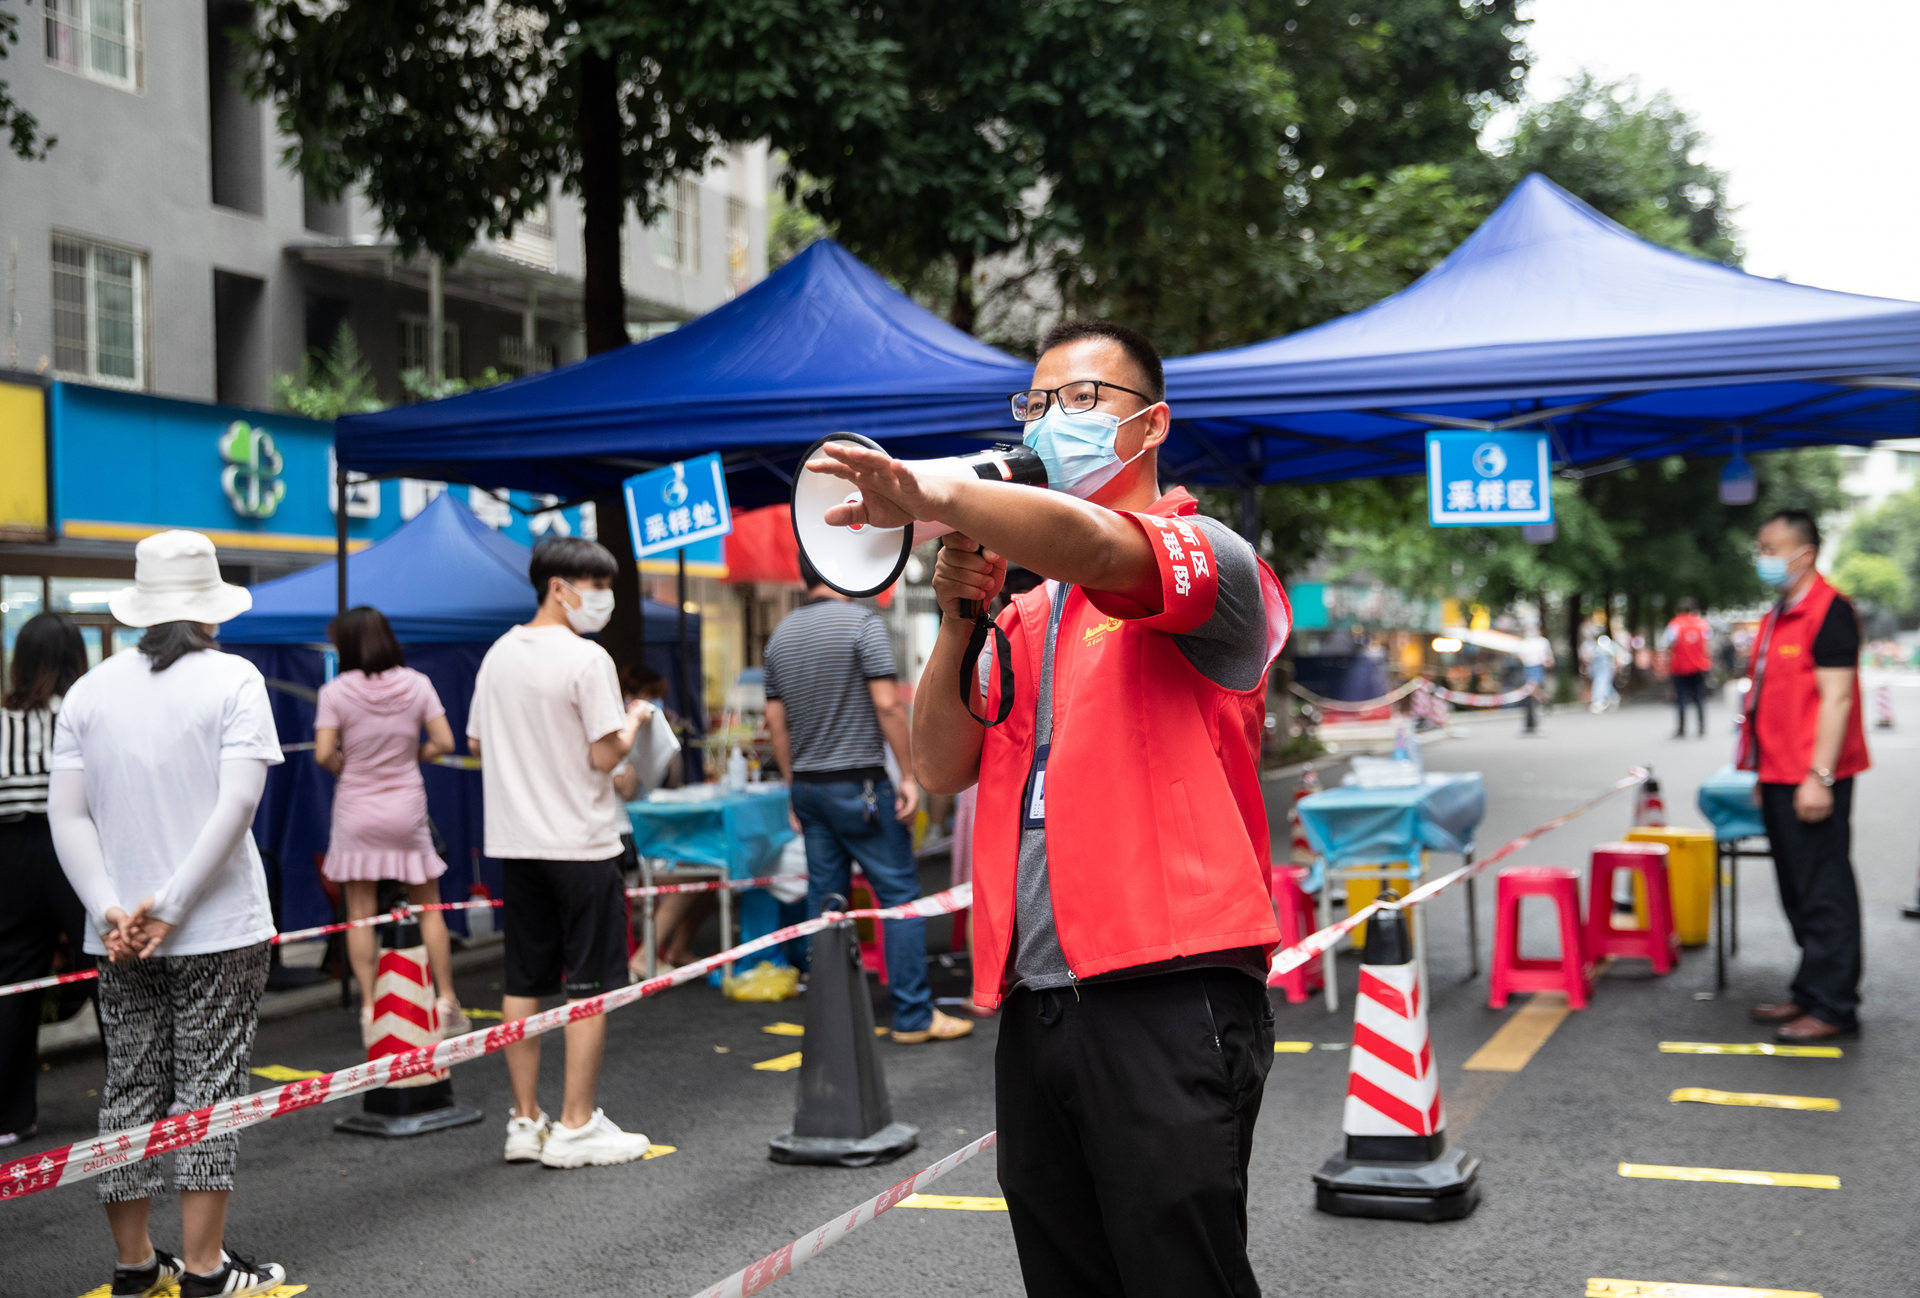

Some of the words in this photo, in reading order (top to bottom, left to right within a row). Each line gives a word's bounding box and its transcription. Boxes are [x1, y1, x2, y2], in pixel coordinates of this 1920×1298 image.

[1447, 479, 1535, 511] 采样区
[645, 500, 717, 542] 采样处
[2, 1174, 51, 1197] SAFE
